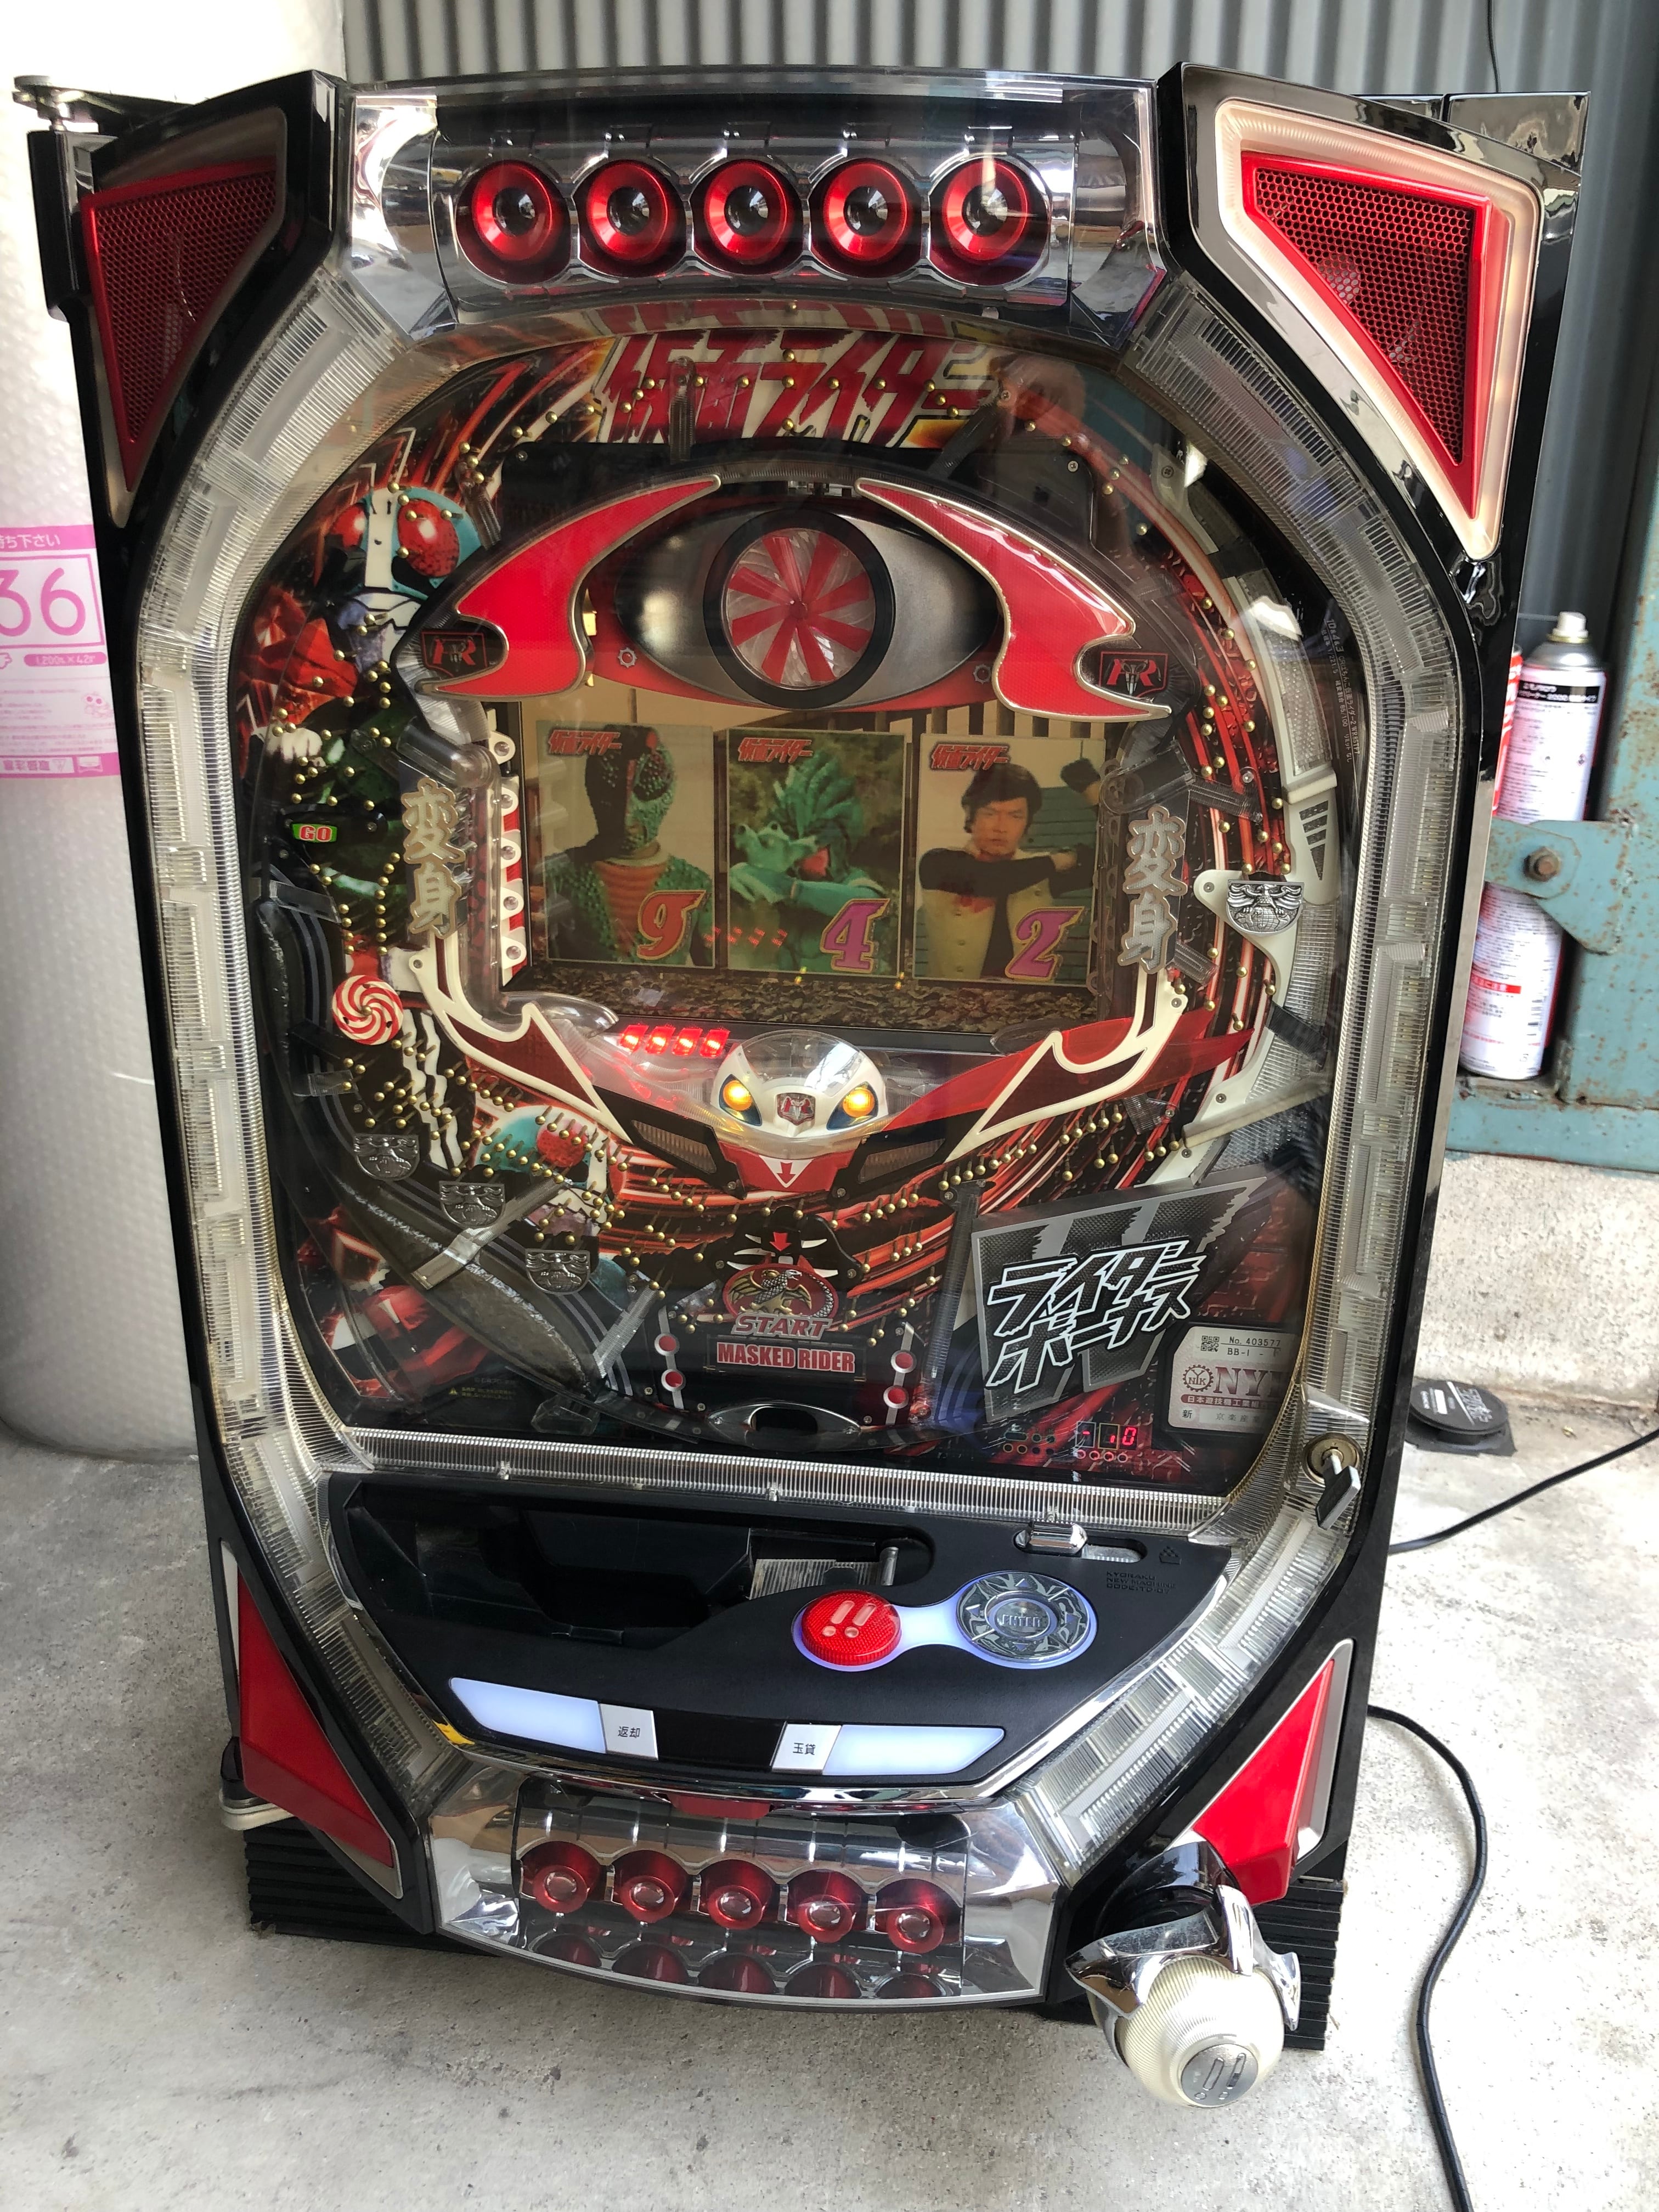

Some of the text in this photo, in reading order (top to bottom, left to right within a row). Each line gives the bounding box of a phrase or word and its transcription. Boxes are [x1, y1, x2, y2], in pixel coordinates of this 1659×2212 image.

[299, 825, 332, 842] GO
[637, 890, 707, 960] 9
[820, 898, 890, 973] 4
[1005, 906, 1085, 981] 2
[732, 1313, 831, 1339] START
[1229, 1336, 1281, 1347] No. 403577
[716, 1342, 855, 1373] MASKED RIDER
[1182, 1409, 1193, 1419] 新
[1107, 1571, 1156, 1581] KYORAKU
[1131, 1579, 1175, 1589] MACHINE
[1002, 1614, 1041, 1627] ENTER
[618, 1726, 640, 1739] 返却
[793, 1742, 816, 1756] 玉貸
